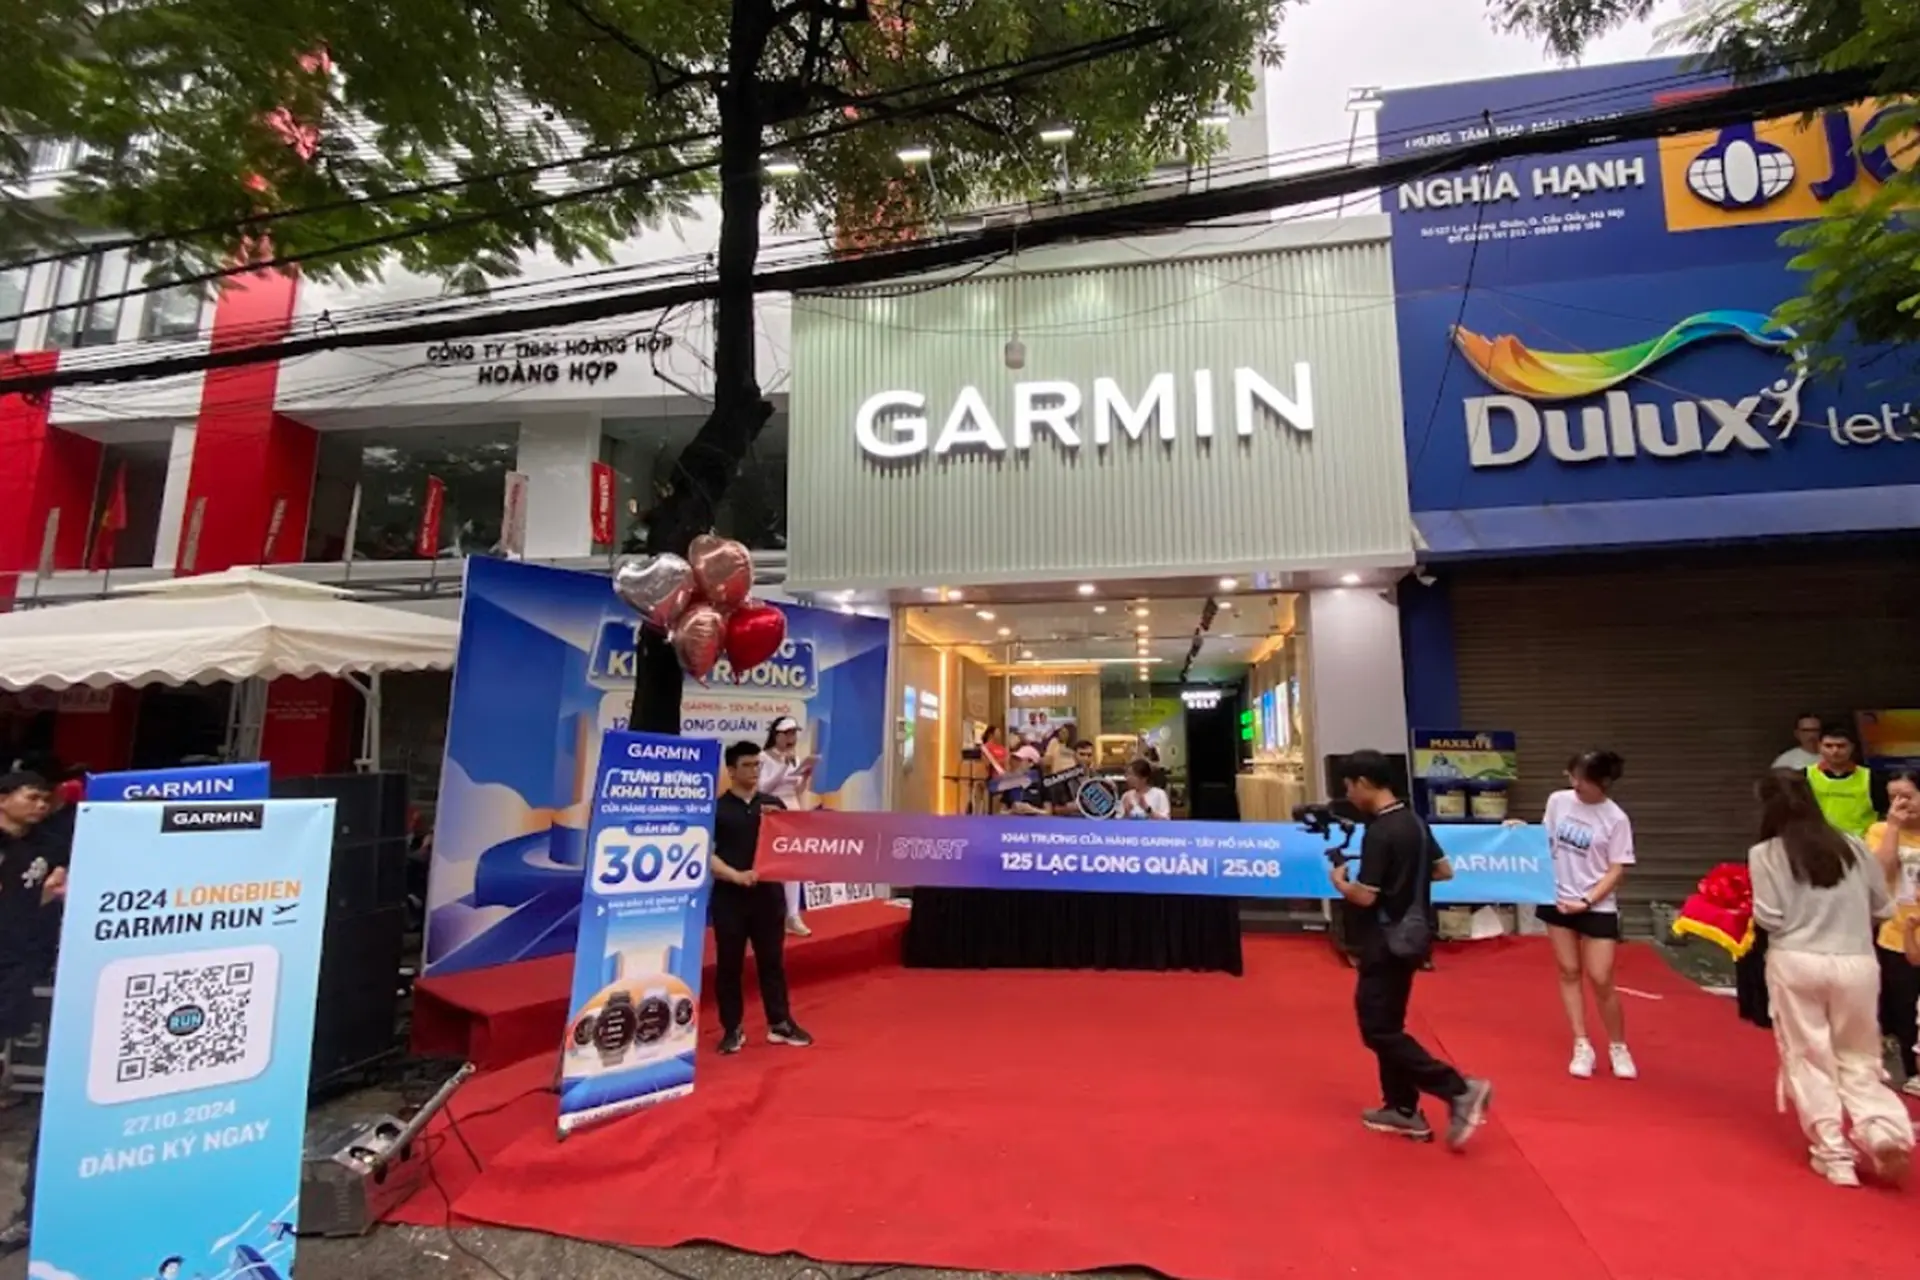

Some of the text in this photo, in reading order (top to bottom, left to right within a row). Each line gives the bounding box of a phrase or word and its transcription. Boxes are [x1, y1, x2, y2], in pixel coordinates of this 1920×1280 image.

[1533, 156, 1647, 202] HẠNH
[478, 360, 618, 386] HOÀNG HỢP
[855, 362, 1314, 457] GARMIN
[1464, 390, 1772, 467] Dulux
[1011, 684, 1068, 697] GARMIN
[628, 743, 701, 761] GARMIN
[123, 778, 234, 799] GARMIN
[609, 785, 648, 799] KHAI
[172, 811, 254, 825] GARMIN
[772, 836, 969, 860] GARMIN START
[1001, 833, 1030, 844] KHAI
[1031, 832, 1078, 845] TRƯƠNG
[1080, 832, 1103, 845] CỬA
[1140, 837, 1187, 848] GARMIN
[1218, 834, 1237, 849] HỒ
[599, 843, 703, 884] 30%
[1000, 852, 1282, 878] 125 LẠC LONG QUÂN 25.08
[1453, 855, 1540, 874] ARMIN
[98, 879, 302, 913] 2024 LONGBIEN
[94, 906, 264, 942] GARMIN RUN
[123, 1098, 237, 1137] 27.10.2024
[162, 1129, 197, 1162] KÝ
[202, 1117, 271, 1153] NGAY
